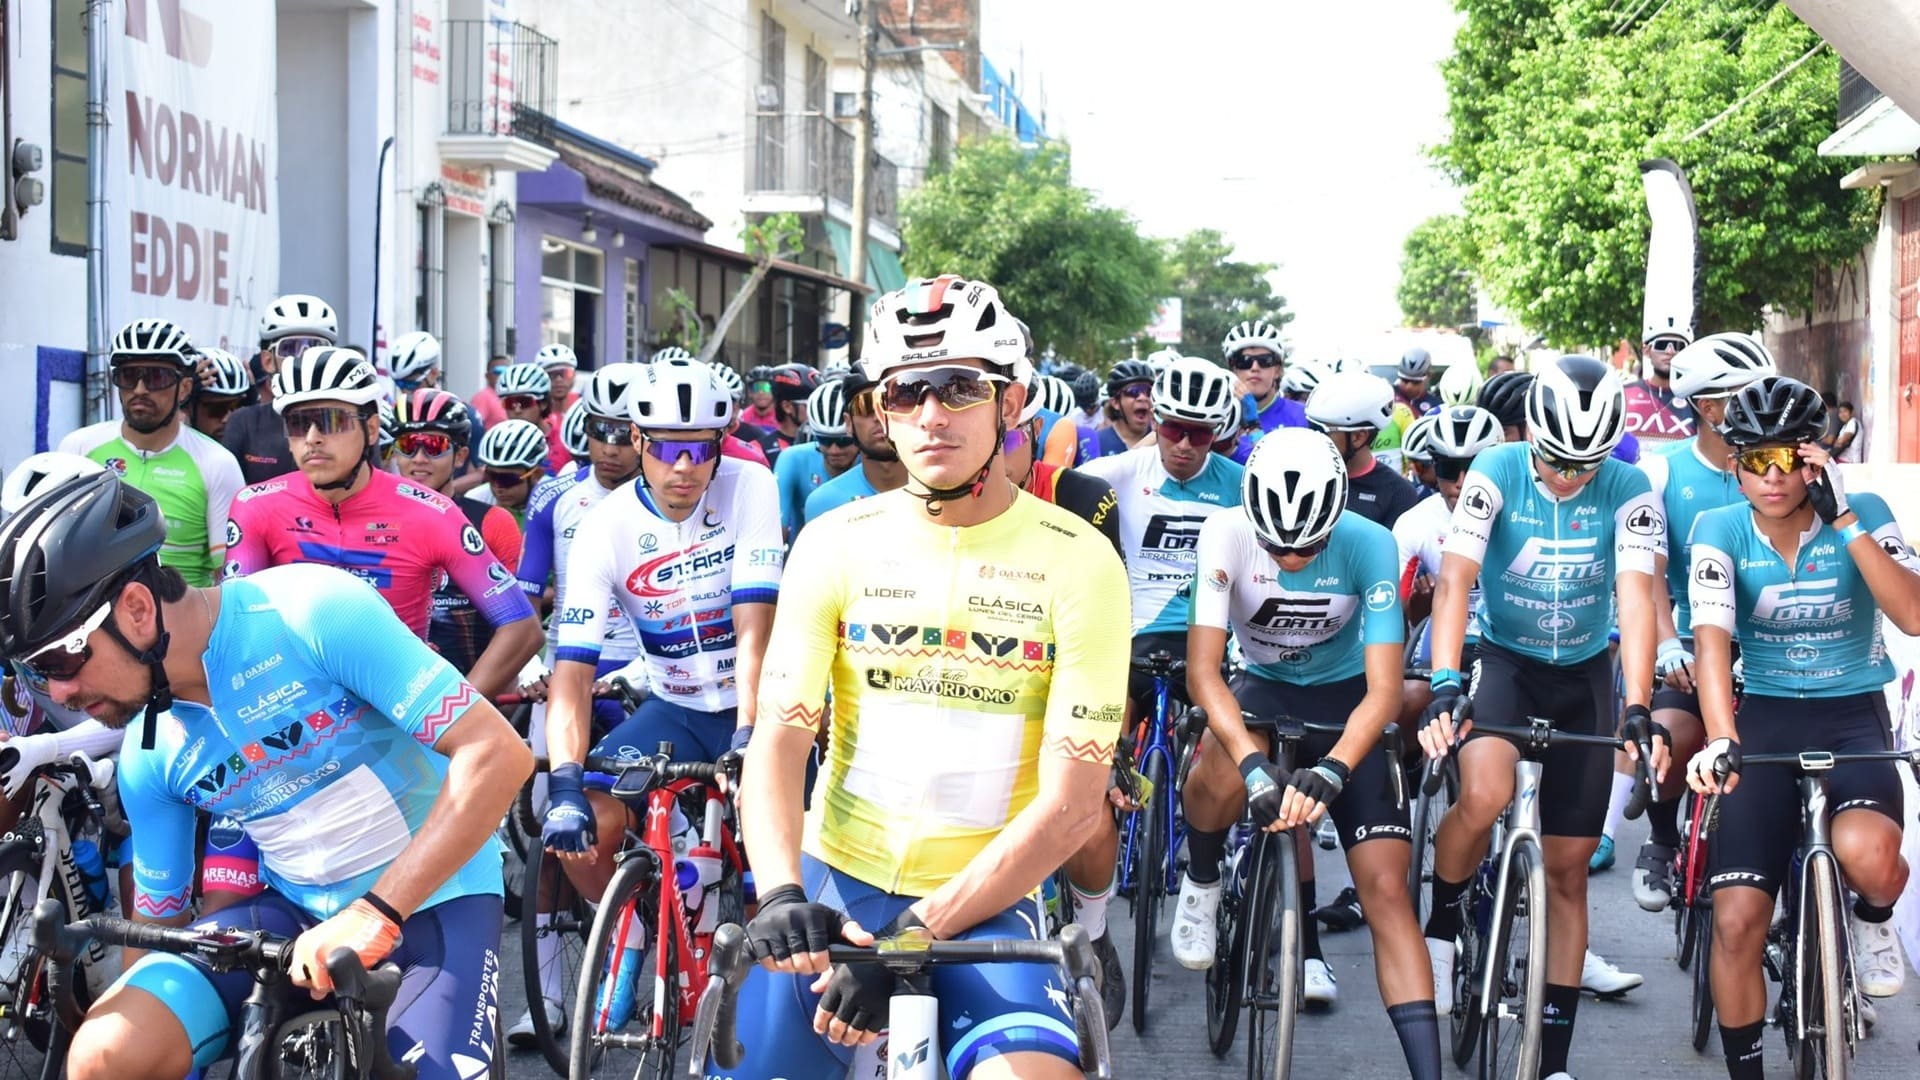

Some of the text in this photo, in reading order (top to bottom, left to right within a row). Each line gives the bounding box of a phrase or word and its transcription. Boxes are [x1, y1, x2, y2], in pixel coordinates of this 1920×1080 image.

[125, 89, 267, 215] NORMAN
[130, 209, 229, 307] EDDIE
[901, 350, 949, 362] SALICE
[864, 587, 916, 599] LIDER
[1501, 573, 1605, 593] INFRAESTRUCTURA
[968, 595, 1044, 615] CLÁSICA
[1504, 592, 1595, 610] PETROLIKE
[1748, 613, 1852, 630] INFRAESTRUCTURA
[1754, 629, 1844, 642] PETROLIKE
[245, 654, 283, 678] OAXACA
[237, 680, 304, 718] CLÁSICA
[894, 676, 1016, 704] MAYORDOMO
[175, 736, 206, 769] LIDER
[203, 867, 257, 884] ARENAS
[1710, 871, 1766, 885] SCOTT
[469, 948, 494, 1047] TRANSPORTES
